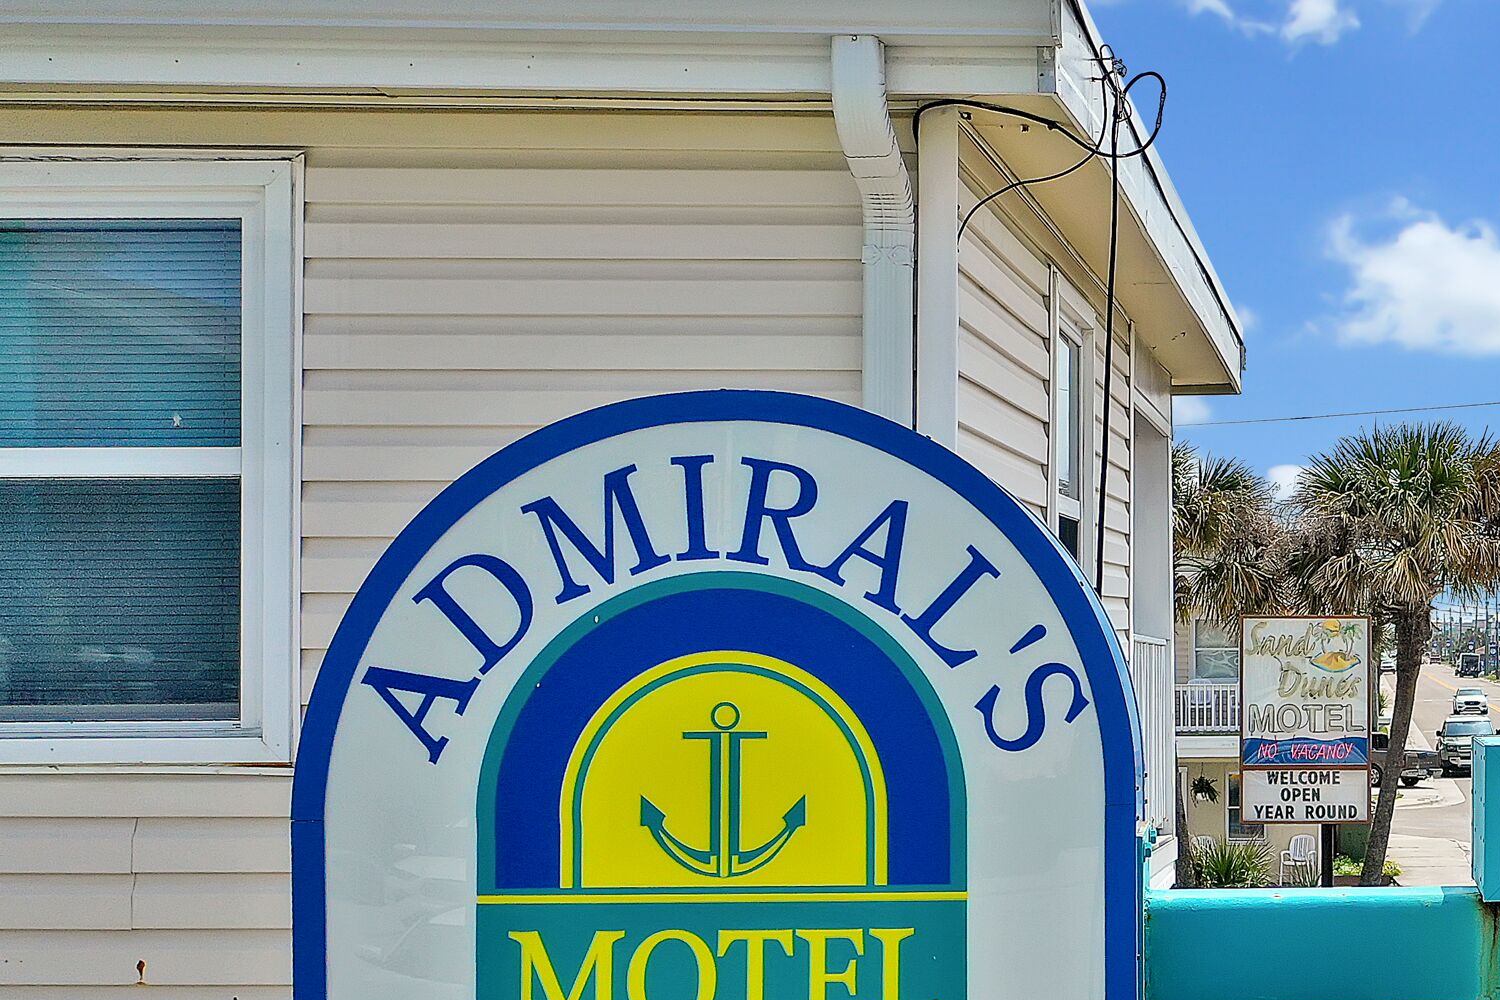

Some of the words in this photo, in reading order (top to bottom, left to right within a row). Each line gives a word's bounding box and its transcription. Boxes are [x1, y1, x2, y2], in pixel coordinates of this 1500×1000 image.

[360, 453, 1091, 765] ADMIRAL'S
[1244, 621, 1317, 657] Sand
[1277, 660, 1362, 699] Dunes
[1248, 703, 1366, 734] MOTEL
[1257, 743, 1279, 760] NO
[1290, 742, 1354, 760] VACANCY
[1267, 771, 1341, 785] WELCOME
[1280, 788, 1321, 802] OPEN
[1253, 805, 1295, 819] YEAR
[1305, 805, 1358, 819] ROUND
